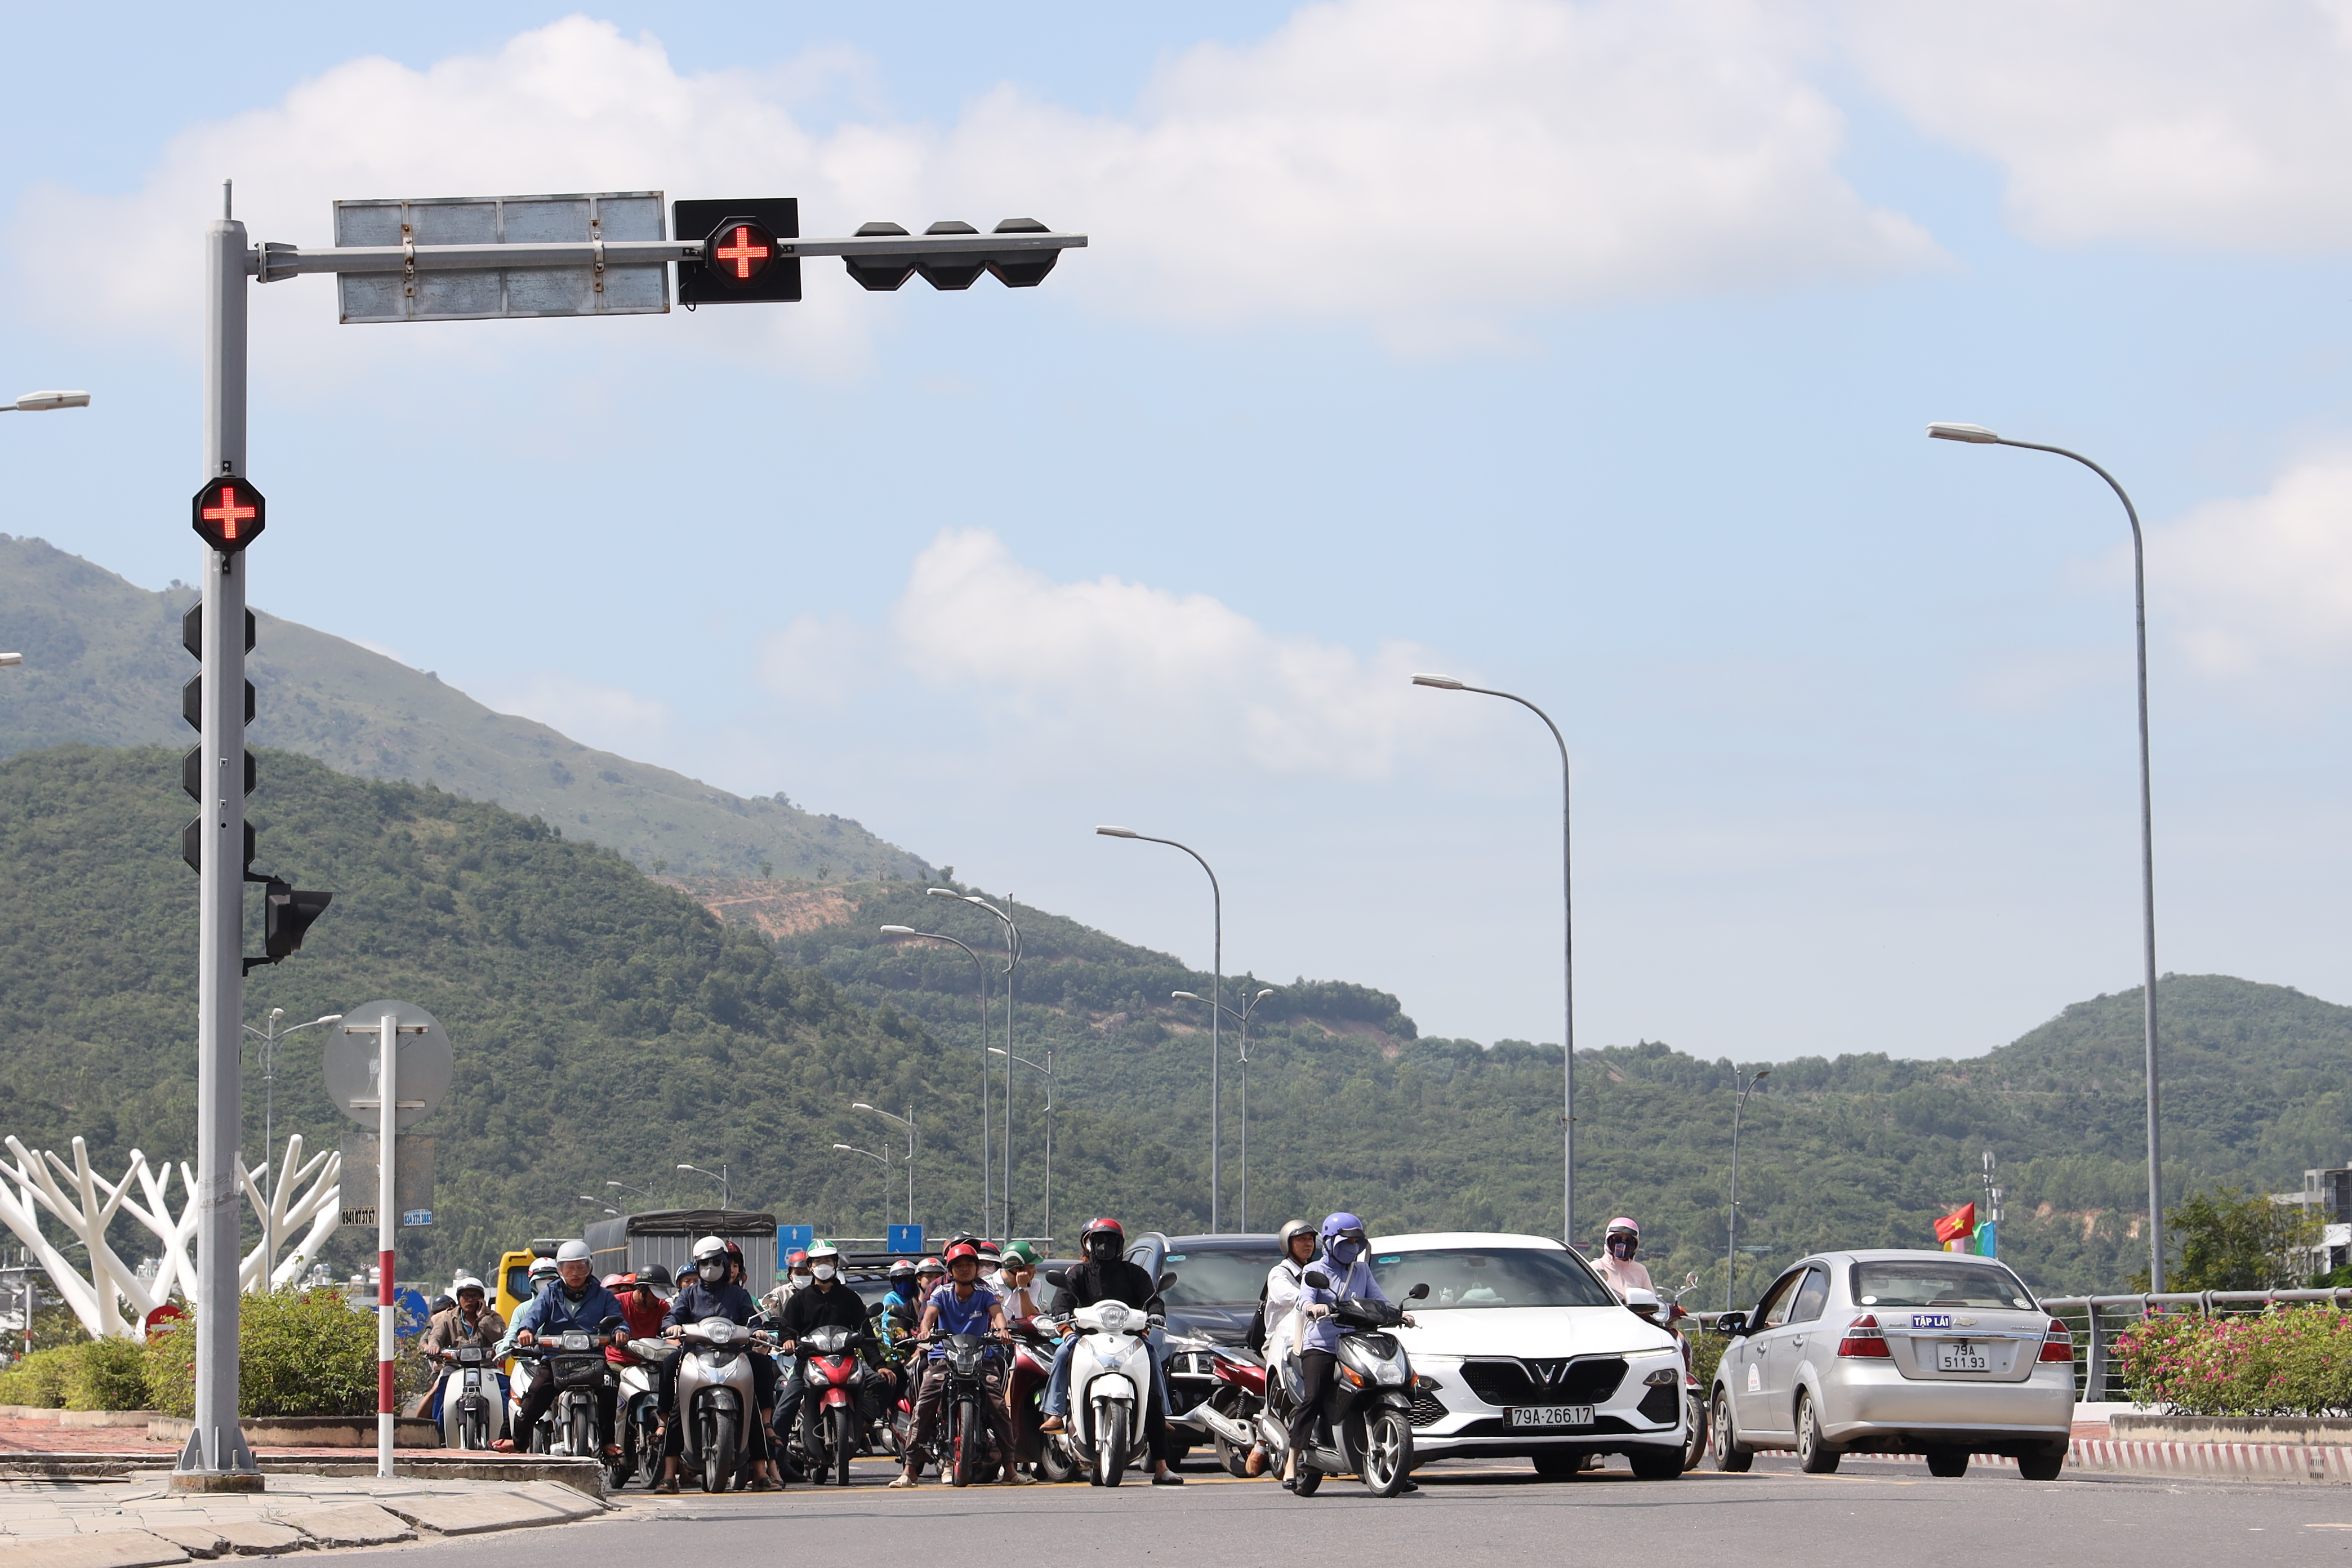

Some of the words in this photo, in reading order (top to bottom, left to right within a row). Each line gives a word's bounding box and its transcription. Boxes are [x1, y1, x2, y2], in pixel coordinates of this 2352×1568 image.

[1914, 1315, 1932, 1328] TẬP
[1934, 1315, 1949, 1326] LÁI
[1953, 1345, 1975, 1356] 79A
[1945, 1357, 1985, 1368] 511.93
[1514, 1407, 1591, 1425] 79A-266.17
